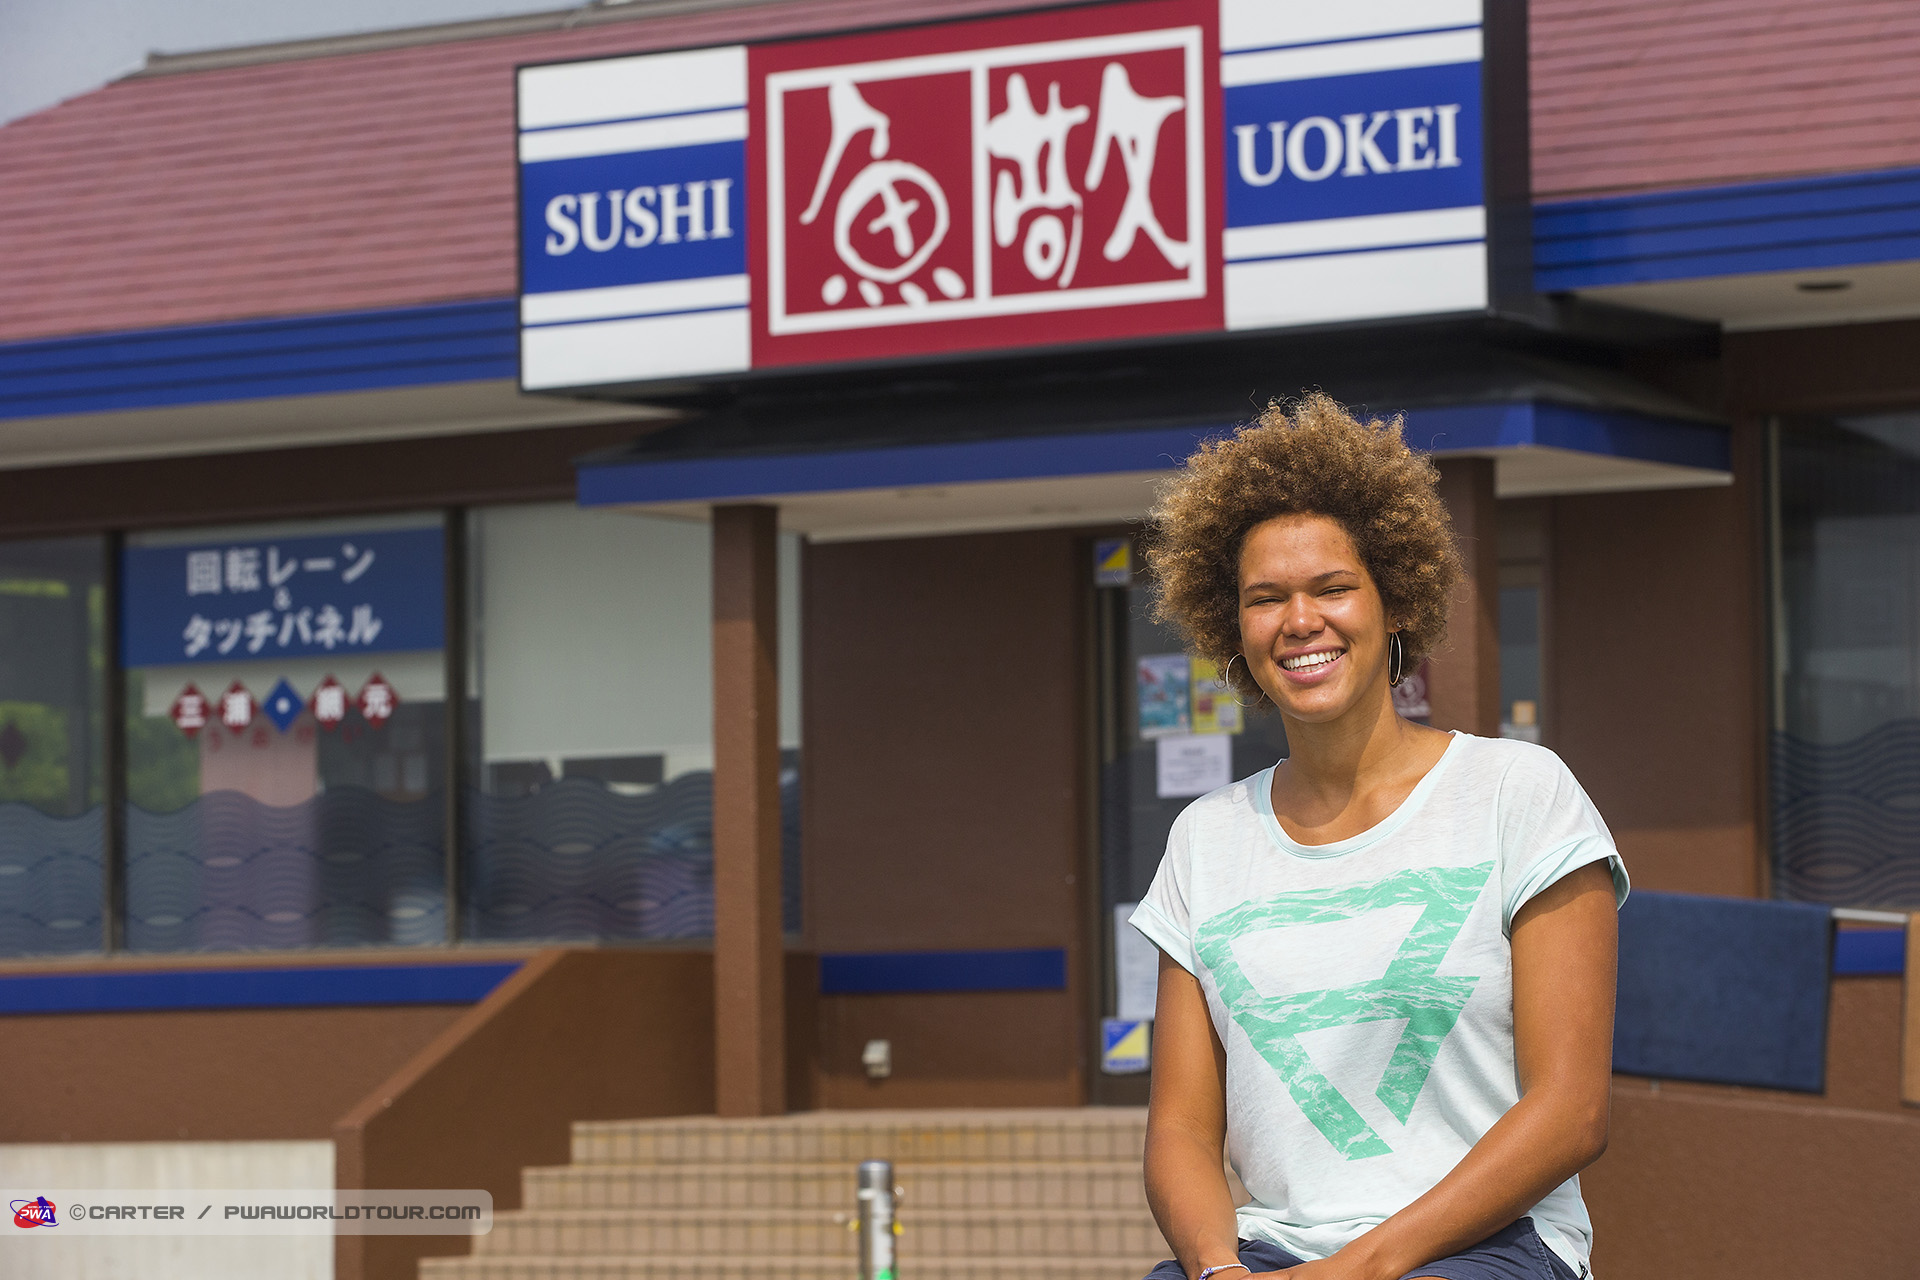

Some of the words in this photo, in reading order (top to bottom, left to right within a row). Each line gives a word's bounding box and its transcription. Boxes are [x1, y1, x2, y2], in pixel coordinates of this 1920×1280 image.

[1234, 104, 1461, 187] UOKEI
[544, 178, 732, 257] SUSHI
[186, 543, 375, 596] 回転レーン
[183, 604, 382, 656] タッチパネル
